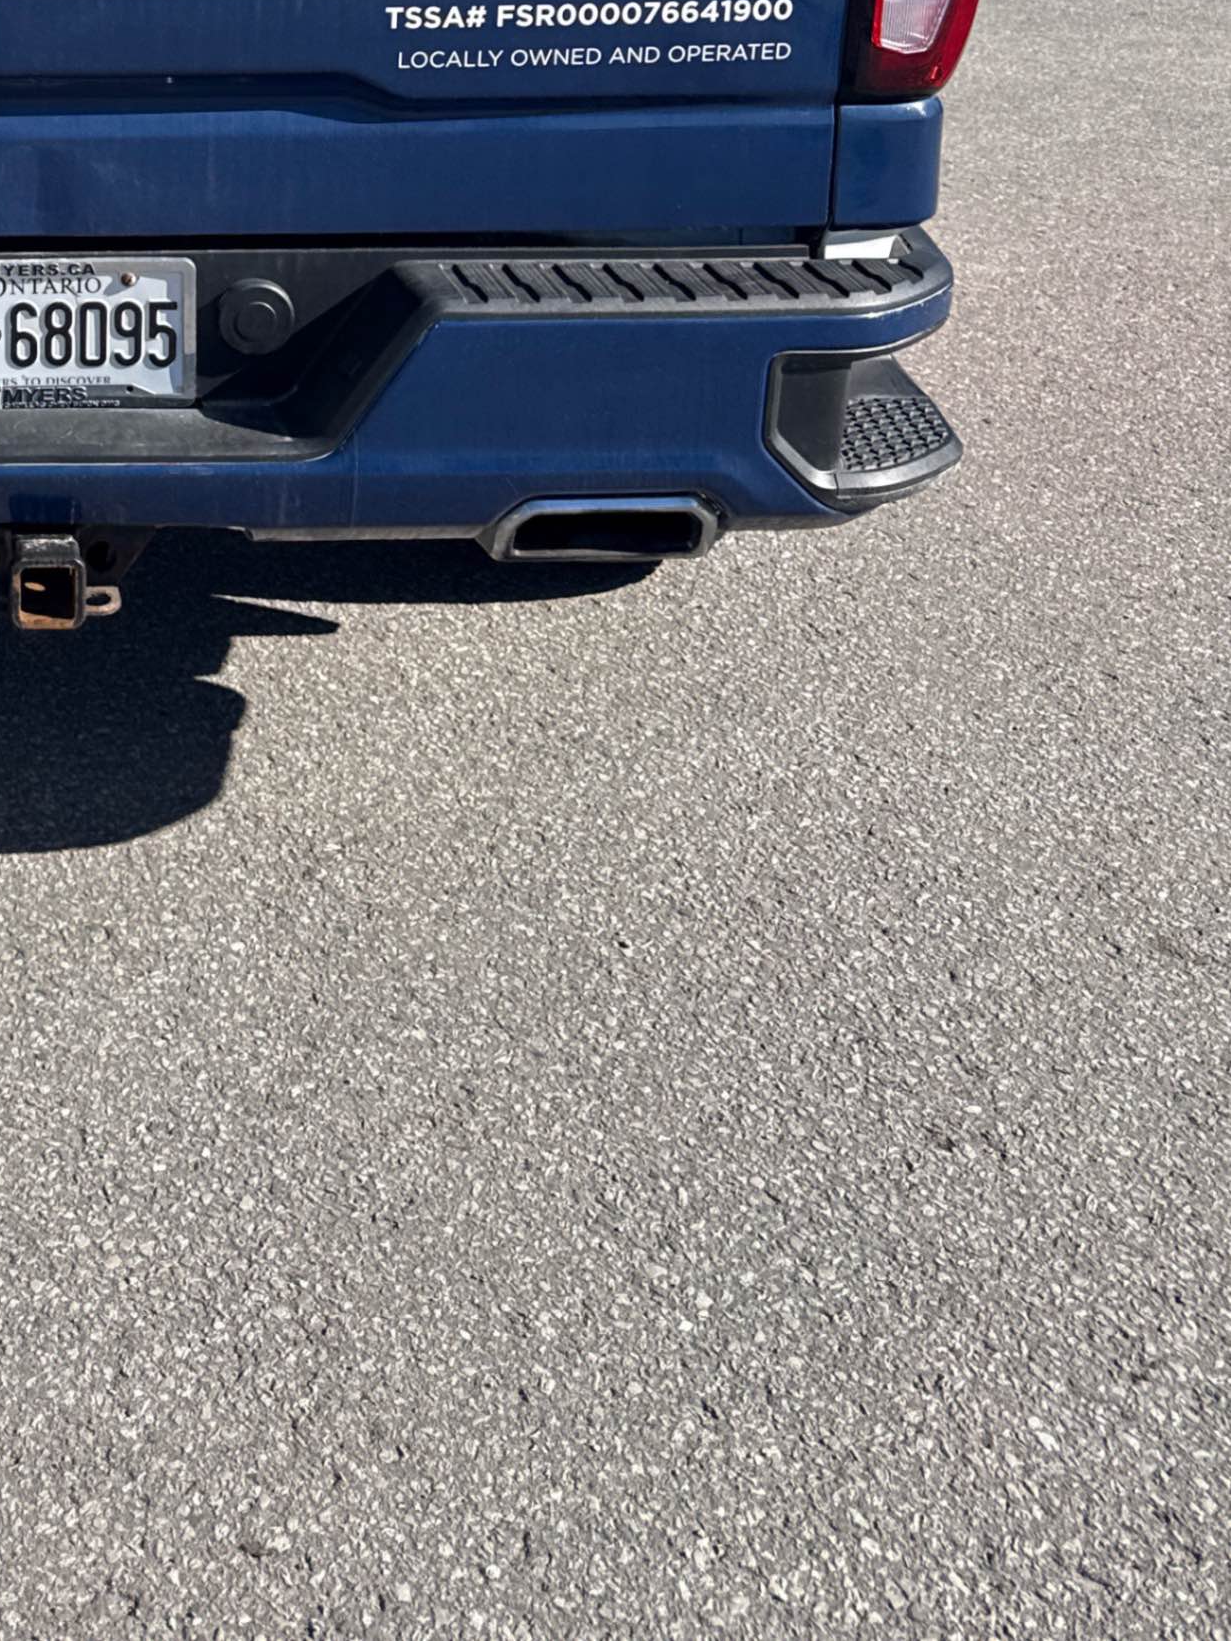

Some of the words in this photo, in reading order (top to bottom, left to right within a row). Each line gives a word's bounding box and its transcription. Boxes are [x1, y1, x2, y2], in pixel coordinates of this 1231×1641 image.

[385, 5, 487, 30] TSSA#
[398, 49, 504, 69] LOCALLY
[510, 47, 602, 67] OWNED
[608, 46, 661, 64] AND
[667, 42, 792, 63] OPERATED
[8, 301, 179, 370] 68095
[46, 375, 111, 385] DISCOVER
[2, 386, 88, 403] MYERS
